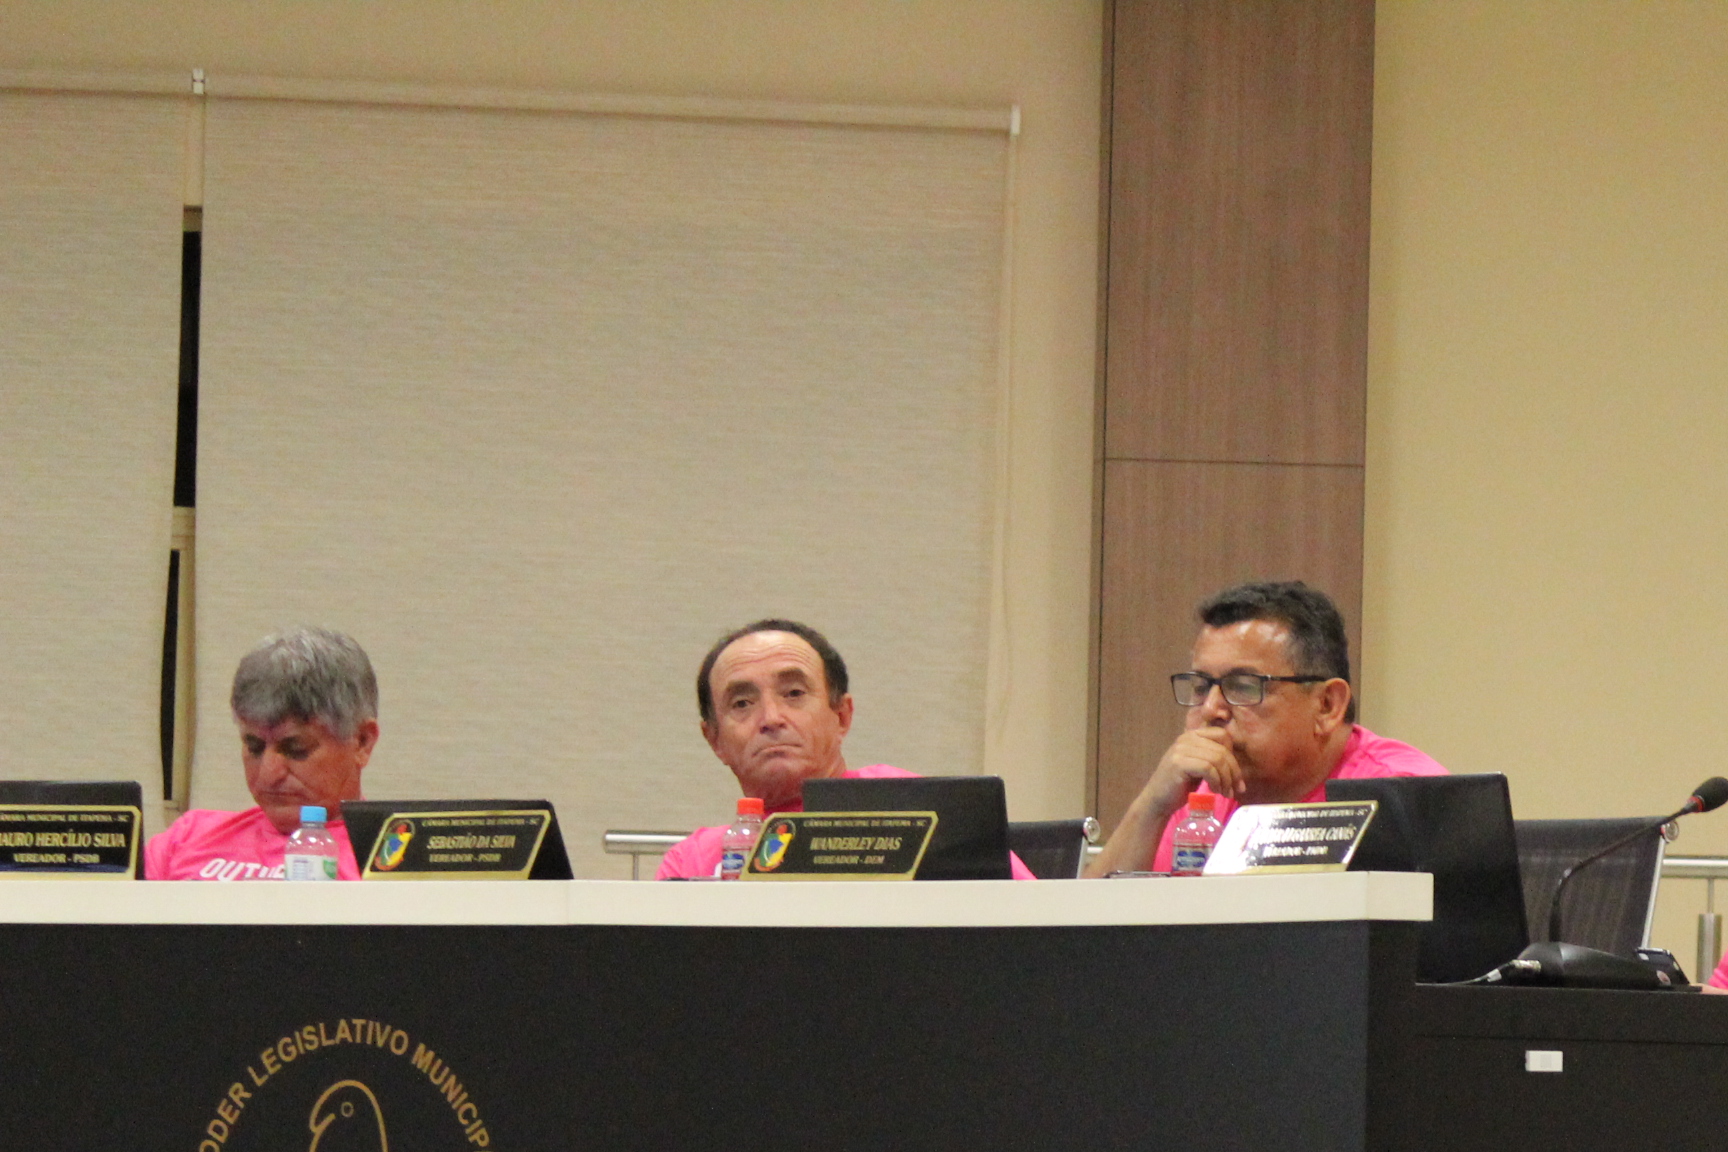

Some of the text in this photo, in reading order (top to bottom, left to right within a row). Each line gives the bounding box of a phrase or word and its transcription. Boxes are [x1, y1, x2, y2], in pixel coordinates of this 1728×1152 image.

[35, 829, 92, 847] HERCÍLIO
[93, 833, 126, 847] SILVA
[810, 837, 903, 850] WANDERLEY DIAS
[13, 853, 67, 863] VEREADOR
[247, 1018, 410, 1088] LEGISLATIVO
